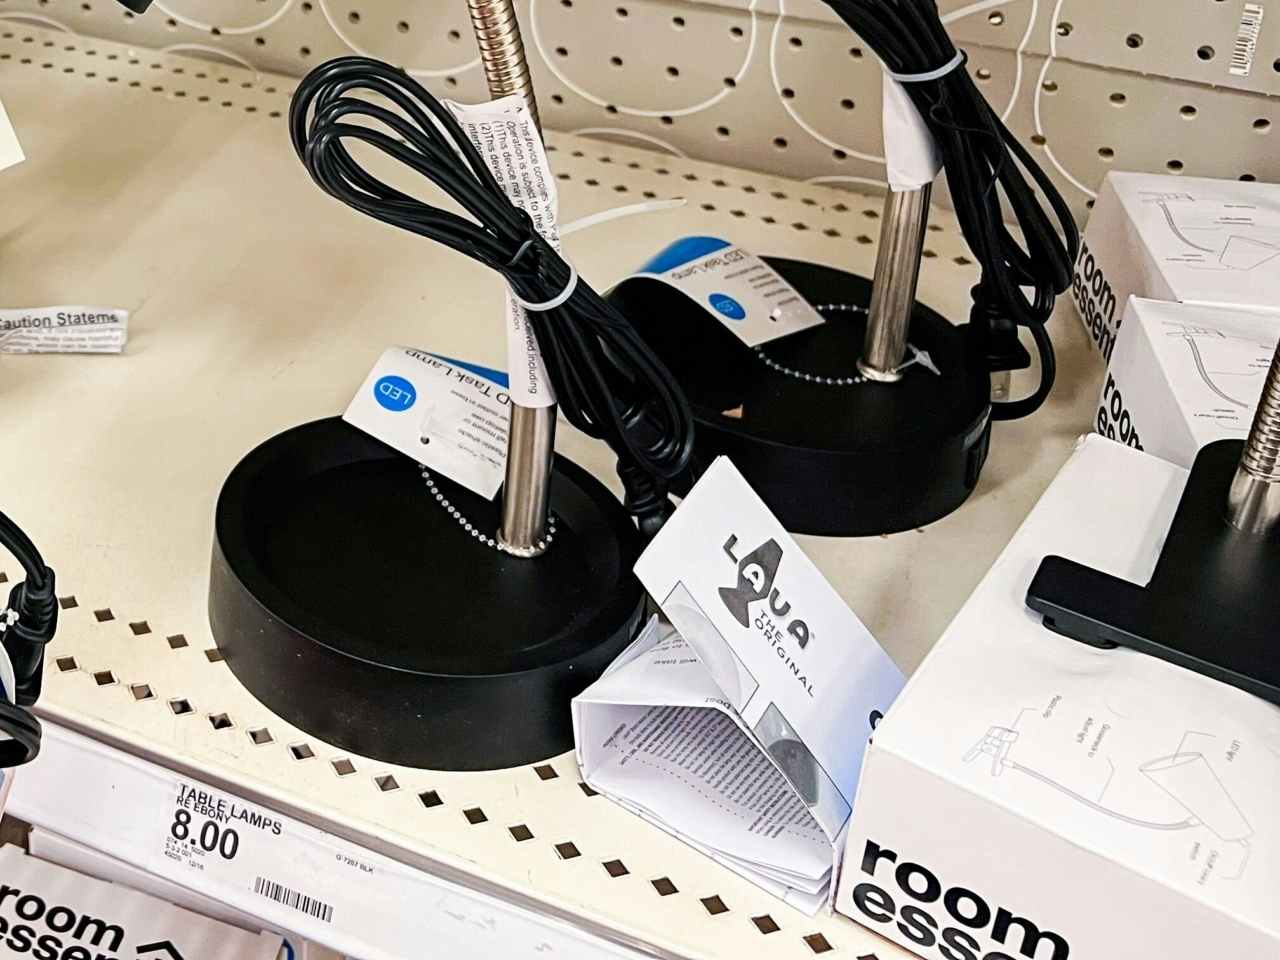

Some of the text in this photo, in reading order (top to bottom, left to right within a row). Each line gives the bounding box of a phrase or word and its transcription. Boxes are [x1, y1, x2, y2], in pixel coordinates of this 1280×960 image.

[490, 155, 505, 181] device
[502, 151, 516, 181] device
[507, 120, 523, 161] Operation
[522, 172, 536, 201] subject
[530, 200, 538, 211] to
[534, 213, 543, 230] the
[1078, 242, 1117, 323] room
[379, 382, 412, 405] LED
[405, 349, 492, 398] Task Lamp
[528, 354, 538, 394] including
[760, 609, 784, 642] THE
[754, 618, 815, 698] ORIGINAL
[176, 797, 232, 825] RE EBONY
[179, 783, 283, 835] TABLE LAMPS
[170, 809, 240, 860] 8.00
[860, 838, 1070, 960] room
